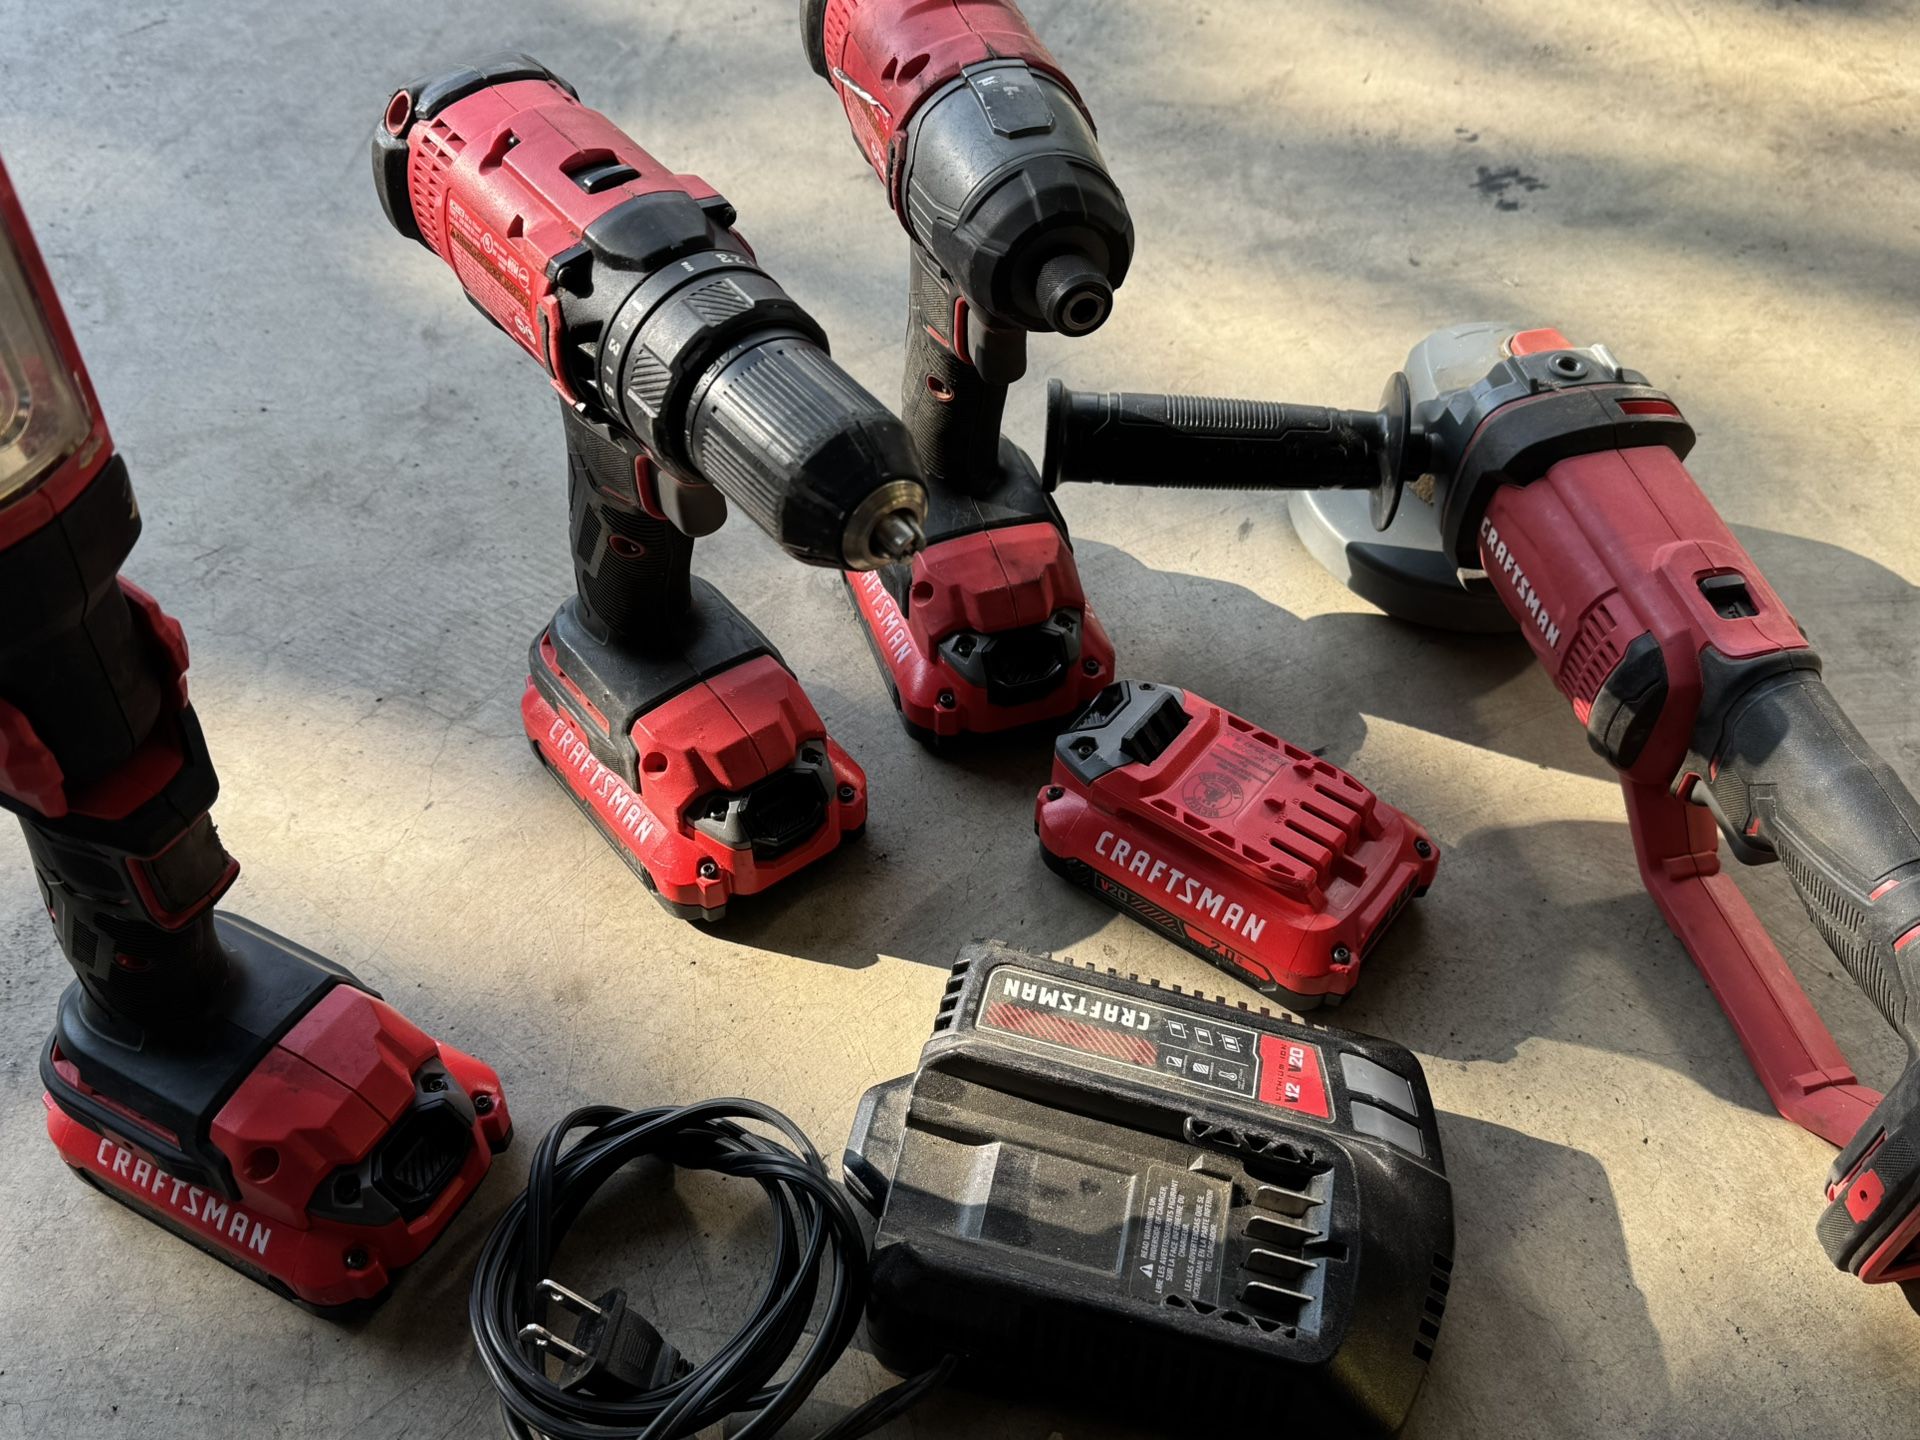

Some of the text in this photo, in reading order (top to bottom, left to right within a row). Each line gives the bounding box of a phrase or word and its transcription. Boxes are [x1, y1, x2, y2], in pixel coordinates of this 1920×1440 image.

[607, 338, 621, 357] 3
[1480, 516, 1560, 648] CRAFTSMAN
[861, 570, 912, 664] AFTSMAN
[549, 718, 654, 845] CRAFTSMAN
[1095, 830, 1267, 943] CRAFTSMAN
[1100, 879, 1128, 902] V20
[1003, 978, 1151, 1031] CRAFTSMAN
[1275, 1044, 1288, 1101] LITHIUM ION
[1284, 1047, 1305, 1103] V12 V20
[96, 1138, 272, 1255] CRAFTSMAN
[1144, 1207, 1155, 1240] WARNINGS
[1160, 1209, 1174, 1263] AVERTISSEMENTS
[1168, 1179, 1179, 1208] FIGURANT
[1141, 1241, 1149, 1259] READ
[1149, 1225, 1161, 1260] UNDERSIDE
[1155, 1215, 1162, 1225] OF
[1168, 1258, 1175, 1267] LA
[1169, 1241, 1178, 1257] FACE
[1184, 1195, 1205, 1292] LEA LAS ADVERTENCIAS QUE SE
[1192, 1189, 1214, 1300] NCUENTRAN EN LA PARTE INFERIOR
[1166, 1267, 1174, 1282] SUR
[1205, 1260, 1213, 1272] DEL
